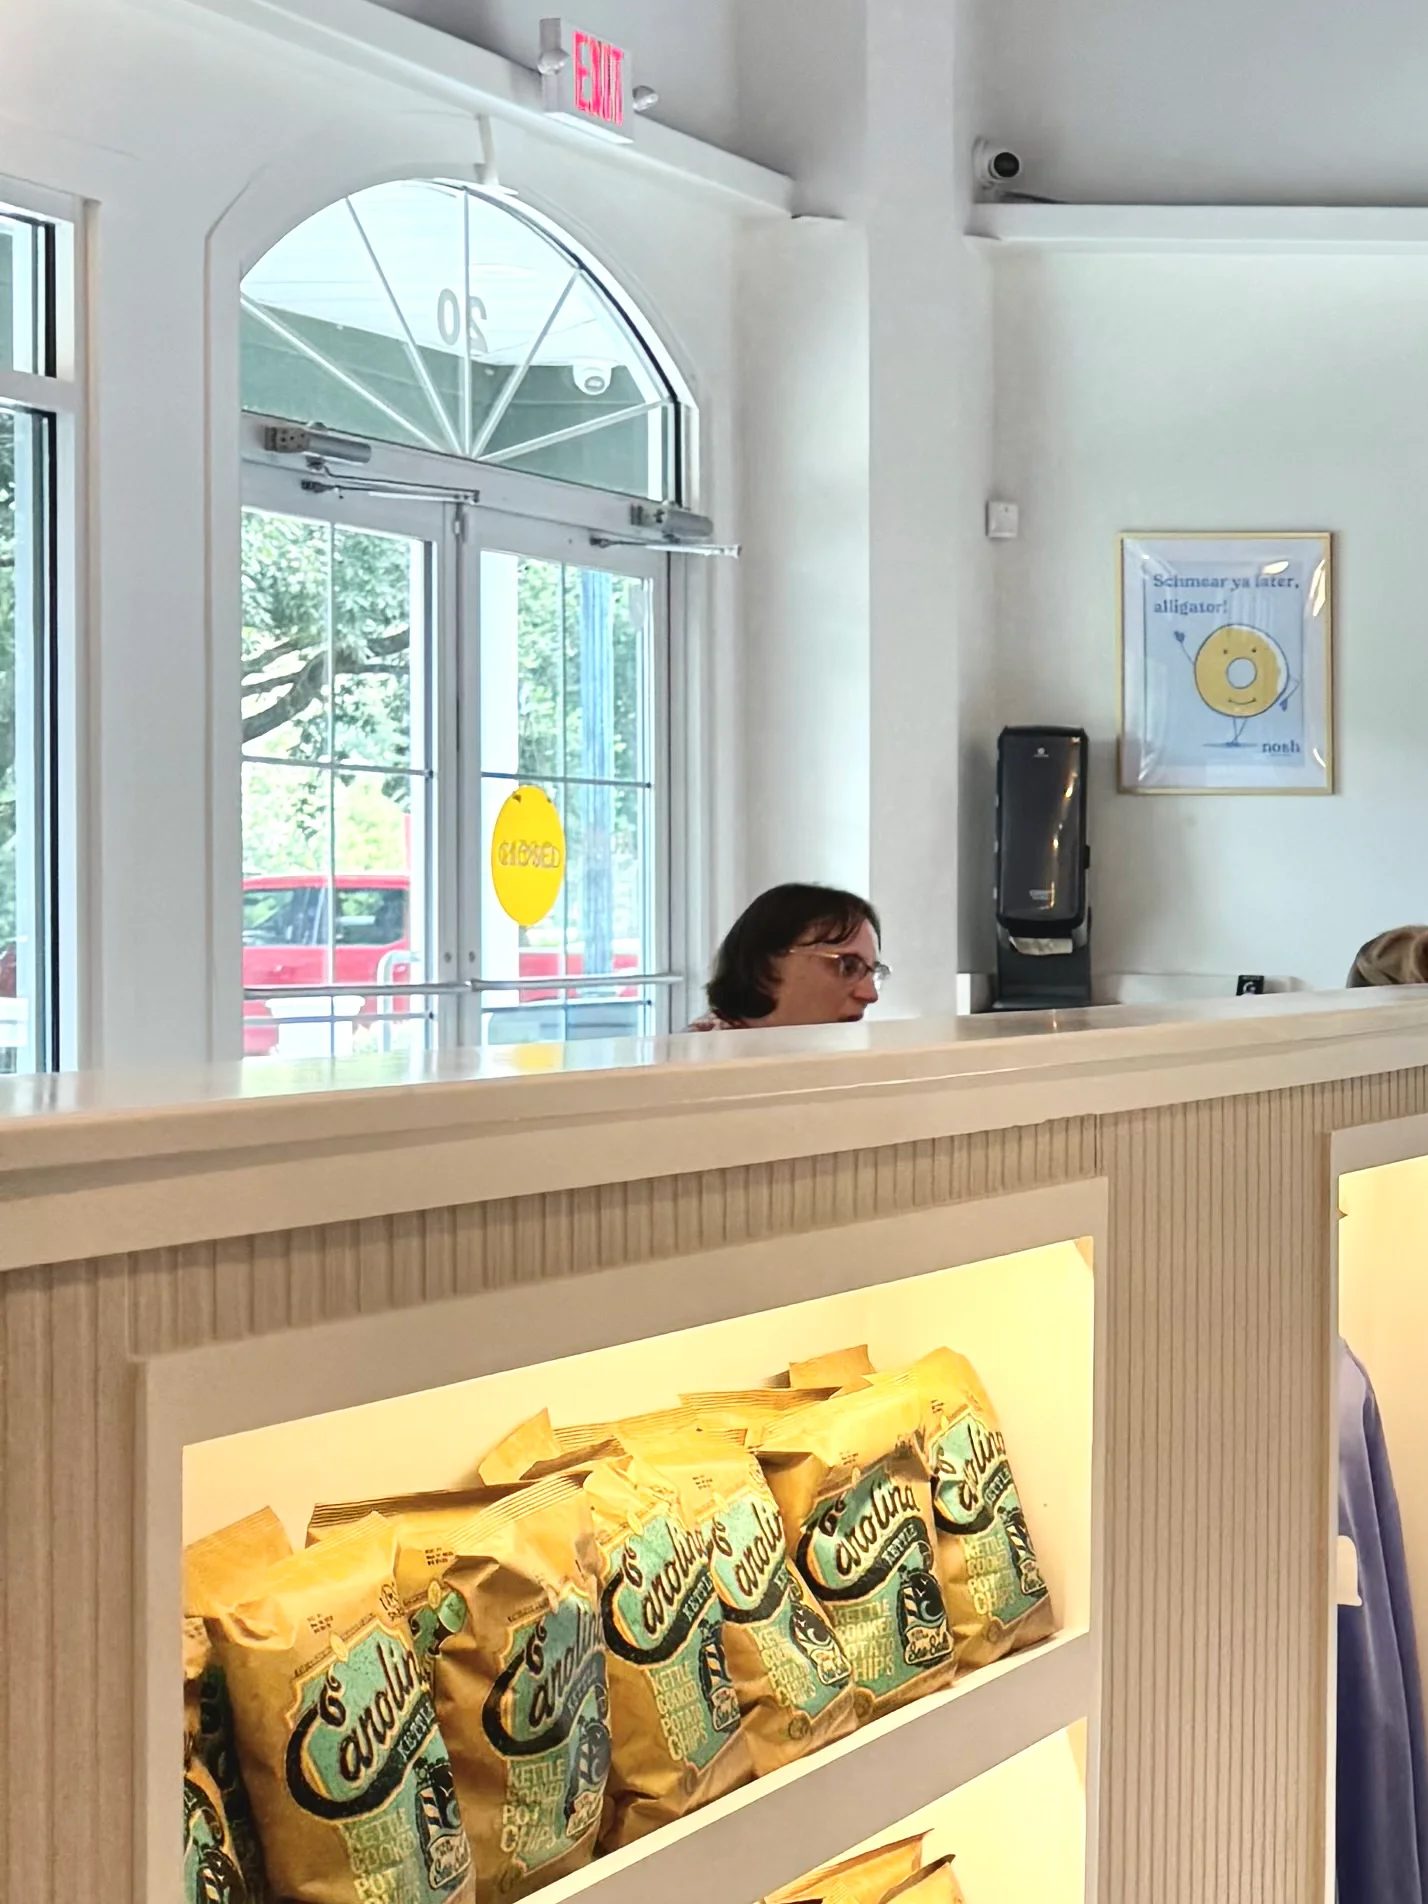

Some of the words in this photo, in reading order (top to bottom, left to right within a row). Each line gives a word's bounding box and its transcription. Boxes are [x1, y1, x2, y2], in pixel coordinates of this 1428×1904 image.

[572, 30, 625, 127] EXIT
[1153, 573, 1226, 589] Schmear
[1230, 576, 1250, 592] ya
[1153, 599, 1228, 616] alligator!
[797, 1479, 922, 1603] Carolina
[285, 1640, 427, 1820] Carolin
